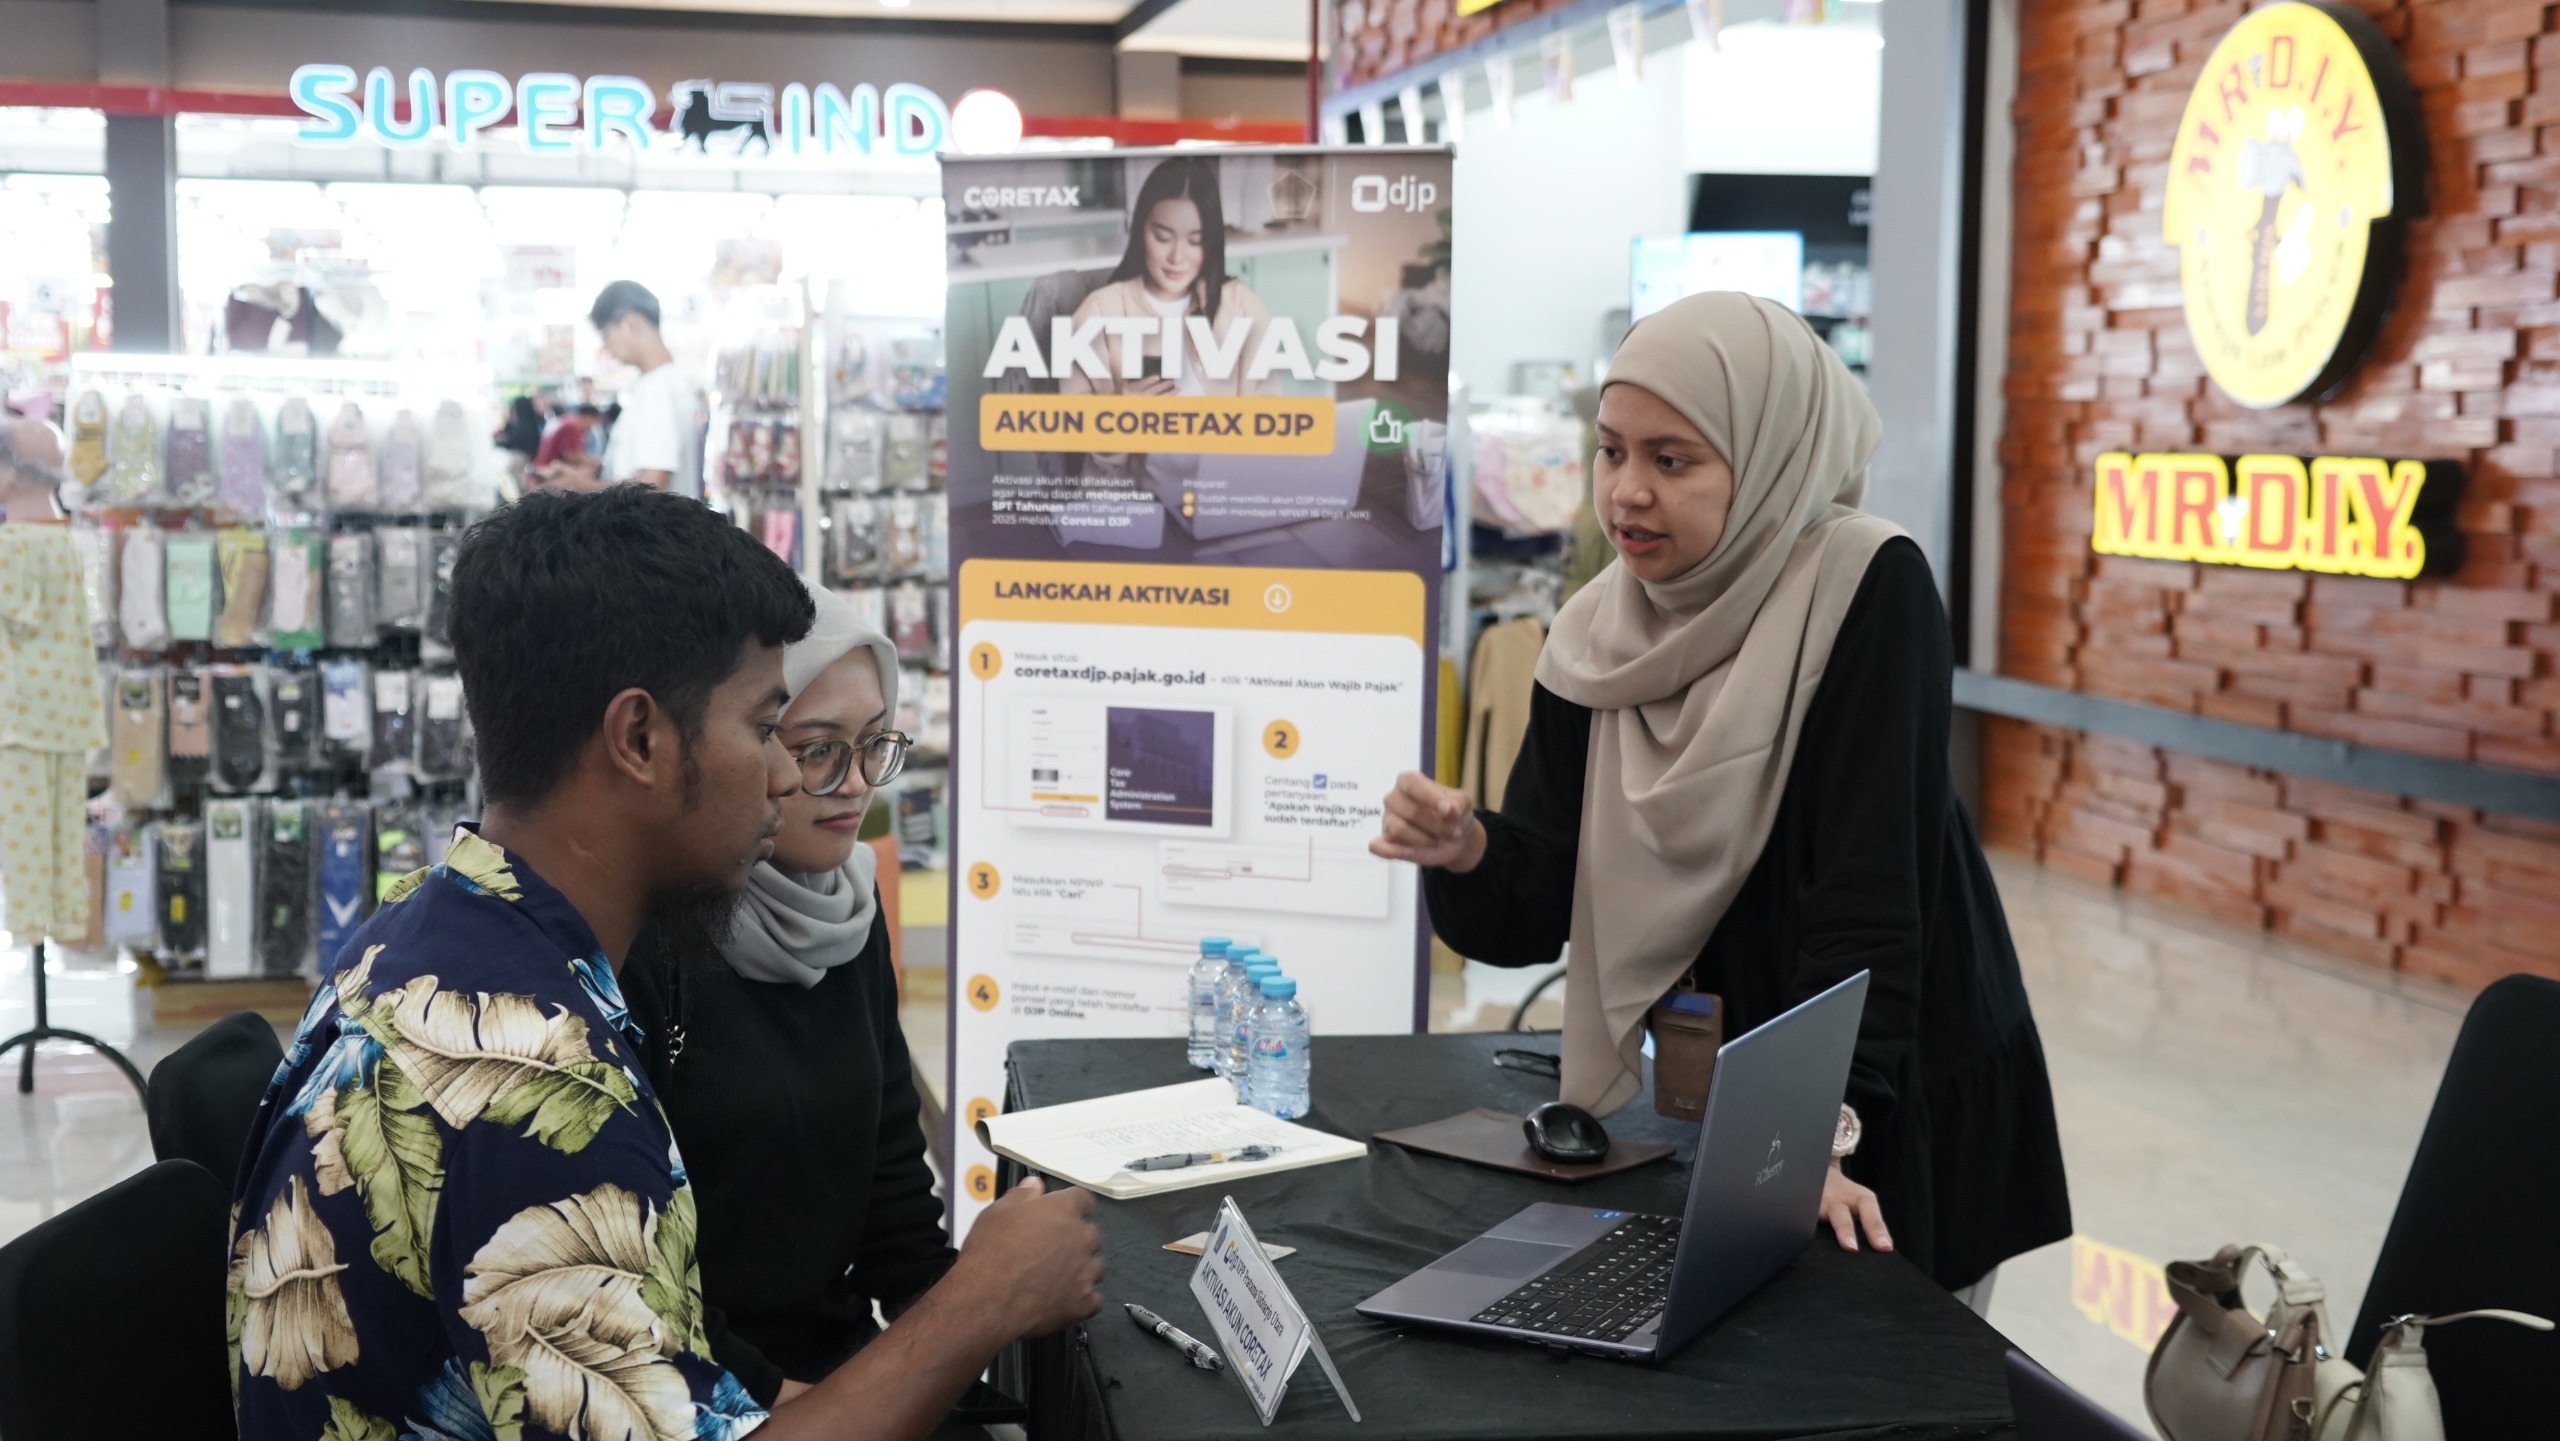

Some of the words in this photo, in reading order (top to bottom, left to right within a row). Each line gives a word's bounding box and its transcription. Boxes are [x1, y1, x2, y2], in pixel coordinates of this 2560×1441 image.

[291, 65, 656, 152] SUPER
[964, 186, 1080, 208] CORETAX
[1389, 175, 1437, 212] djp
[983, 315, 1400, 382] AKTIVASI
[995, 410, 1084, 433] AKUN
[1095, 411, 1243, 435] CORETAX
[1253, 413, 1314, 436] DJP
[992, 474, 1032, 486] Aktivasi
[1035, 475, 1062, 486] akun
[1064, 474, 1078, 486] ini
[1081, 474, 1134, 487] dilakukan
[992, 490, 1015, 501] agar
[1018, 488, 1049, 499] kamu
[1051, 488, 1083, 501] dapat
[1085, 489, 1153, 502] melaporkan
[992, 501, 1012, 512] SPT
[1015, 501, 1064, 513] Tahunan
[1091, 503, 1124, 514] tahun
[1126, 503, 1155, 516] pajak
[1345, 510, 1370, 522] (NIK)
[992, 515, 1016, 525] 2025
[1019, 515, 1057, 526] melalui
[1060, 515, 1105, 527] Coretax
[995, 581, 1111, 602] LANGKAH
[1118, 584, 1230, 606] AKTIVASI
[980, 652, 988, 671] 1
[1014, 651, 1049, 663] Masuk
[1051, 652, 1079, 663] situs:
[1014, 665, 1205, 686] coretaxdjp.pajak.go.id
[1220, 675, 1241, 686] Klik
[1296, 679, 1325, 689] Akun
[1328, 680, 1361, 692] Wajib
[1274, 730, 1288, 749] 2
[1109, 767, 1132, 778] Core
[1264, 775, 1310, 790] Centang
[1329, 780, 1358, 792] pada
[1109, 789, 1176, 802] Administration
[1264, 789, 1328, 802] pertanyaan:
[1109, 801, 1142, 811] System
[1313, 803, 1345, 816] Wajib
[1349, 805, 1381, 819] Pajak
[1264, 813, 1297, 825] sudah
[977, 872, 989, 890] 3
[1012, 875, 1066, 887] Masukkan
[1069, 877, 1104, 889] NPWP
[1033, 887, 1053, 899] klik
[975, 984, 990, 1003] 4
[1011, 981, 1039, 994] Input
[1079, 986, 1098, 997] dan
[1101, 989, 1136, 1000] nomor
[1011, 994, 1046, 1005] ponsel
[1049, 997, 1075, 1009] yang
[1077, 997, 1102, 1010] telah
[1105, 1001, 1150, 1014] terdaftar
[1024, 1006, 1046, 1017] DJP
[1256, 1039, 1282, 1053] Club
[974, 1174, 989, 1194] 6
[1201, 1260, 1230, 1310] AKTIVASI
[1222, 1297, 1245, 1337] AKUN
[1239, 1323, 1274, 1383] CORETAX
[1271, 1310, 1285, 1337] Utara
